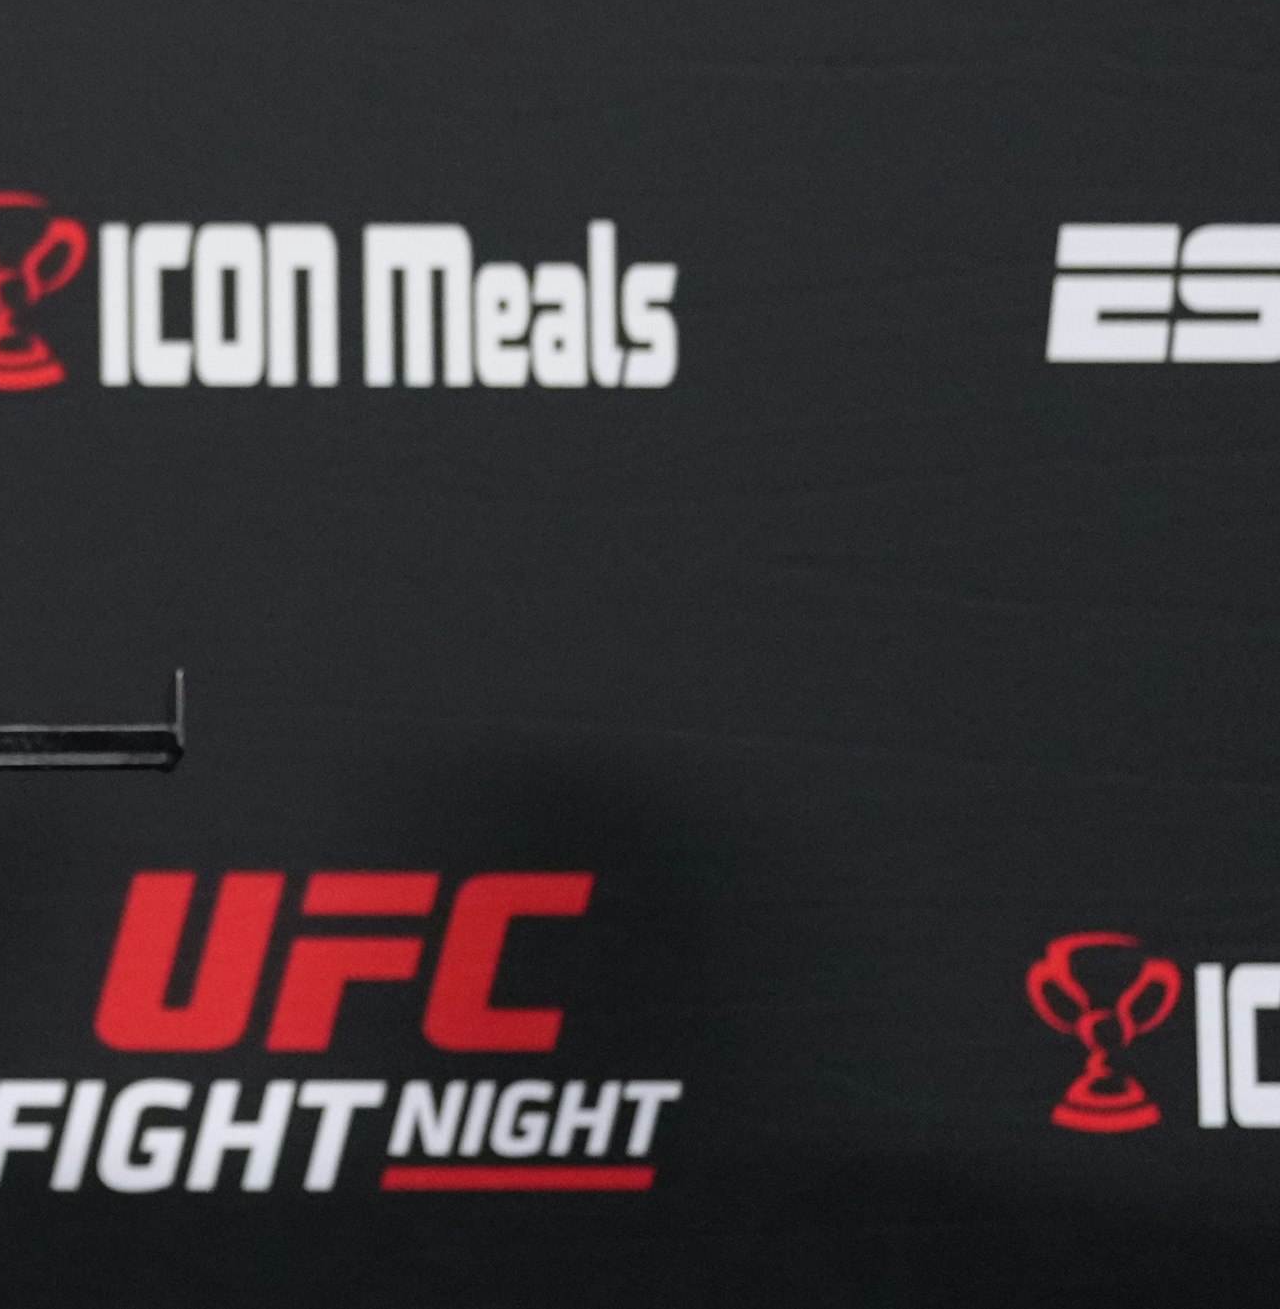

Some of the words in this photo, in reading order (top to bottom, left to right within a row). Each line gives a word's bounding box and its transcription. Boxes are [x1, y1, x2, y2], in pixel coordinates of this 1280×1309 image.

[97, 222, 340, 388] ICON
[362, 219, 679, 389] Meals
[92, 870, 595, 1053] UFC
[386, 1079, 682, 1157] NIGHT
